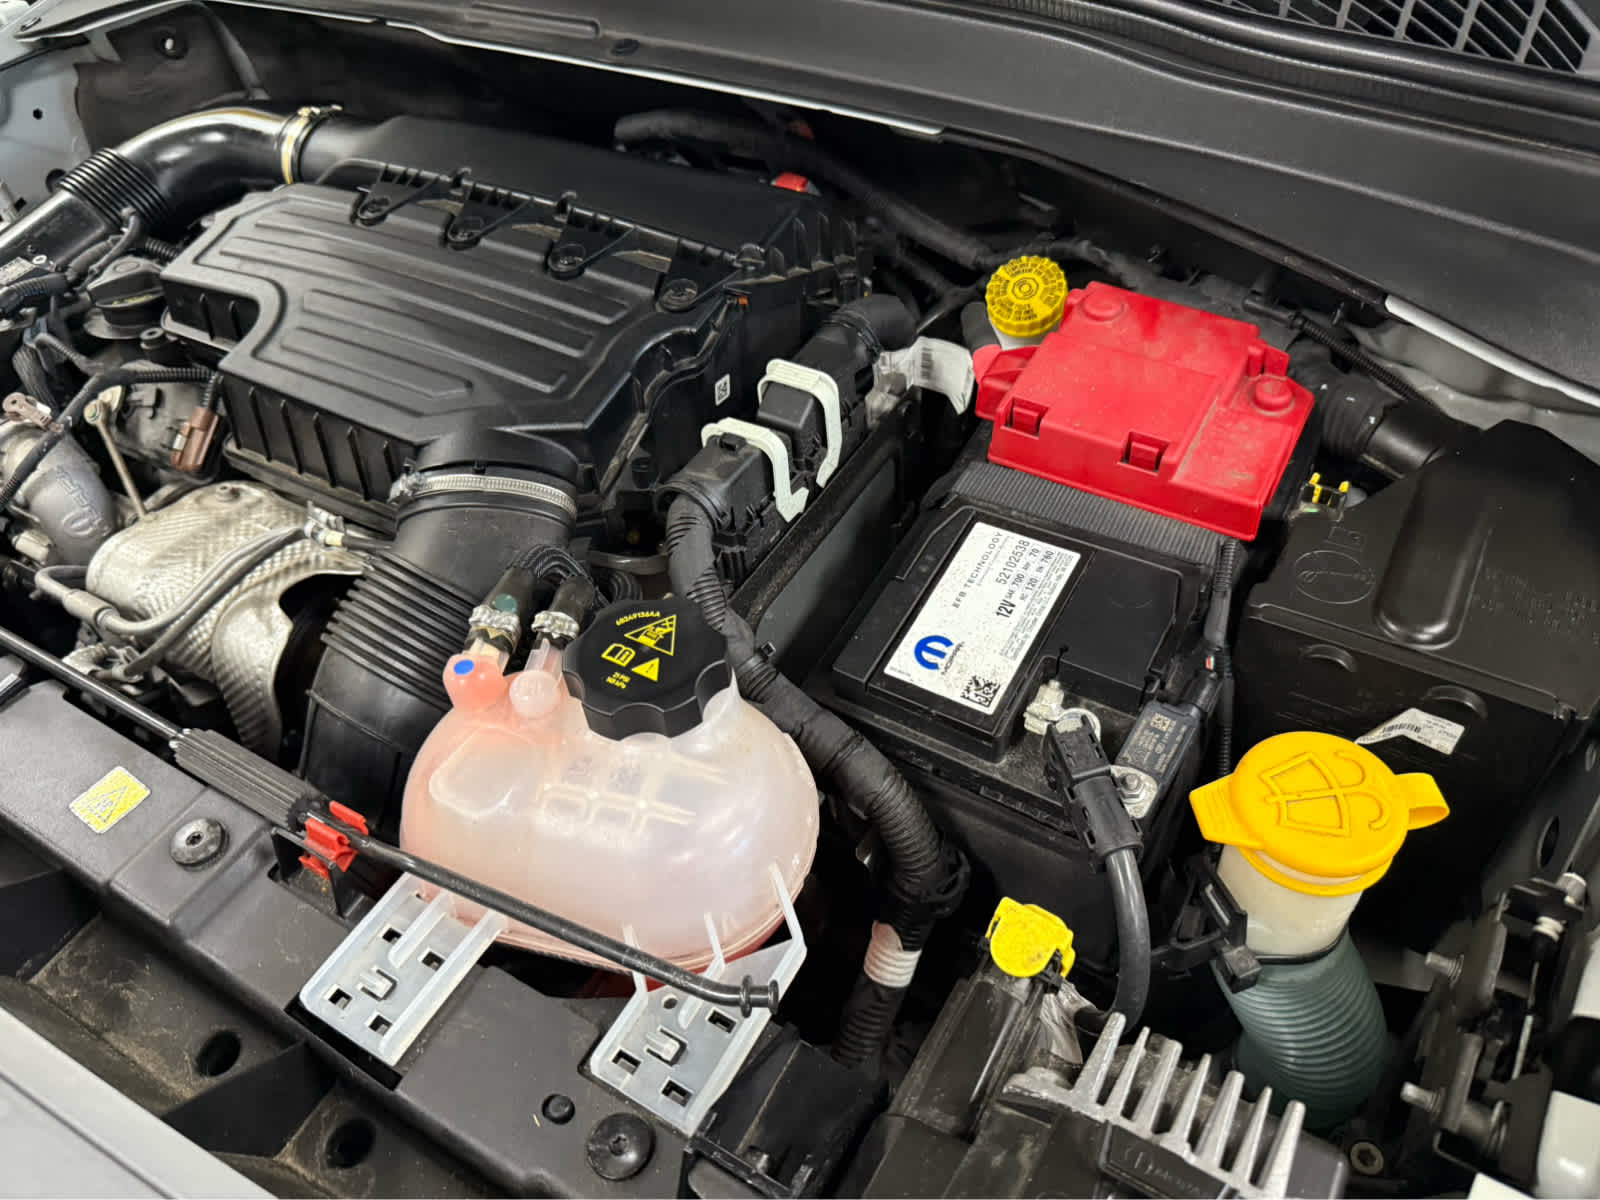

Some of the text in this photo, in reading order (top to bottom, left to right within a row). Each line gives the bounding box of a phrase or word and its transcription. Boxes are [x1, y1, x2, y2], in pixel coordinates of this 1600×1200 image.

[964, 532, 1003, 588] TECHNOLOGY
[995, 540, 1030, 585] 52102538
[995, 599, 1016, 618] 12V
[1011, 573, 1025, 587] 700
[1028, 547, 1041, 558] 70
[1025, 577, 1039, 591] 120
[1041, 550, 1055, 564] 760
